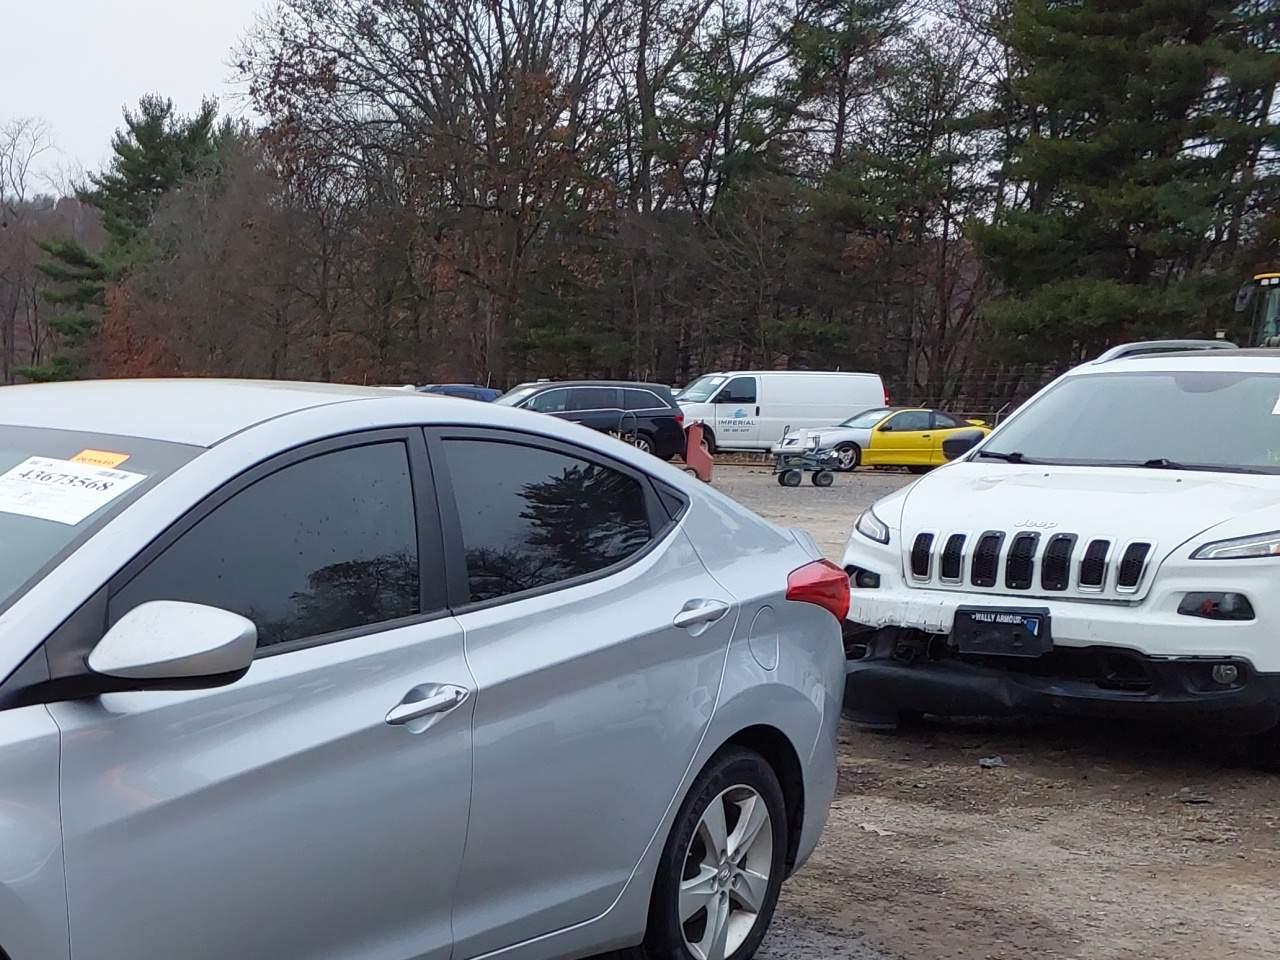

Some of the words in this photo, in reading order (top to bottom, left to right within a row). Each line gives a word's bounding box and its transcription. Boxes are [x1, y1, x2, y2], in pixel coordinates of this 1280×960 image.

[19, 469, 114, 491] 43673568
[1014, 519, 1058, 530] Jeep
[975, 612, 995, 622] WALLY
